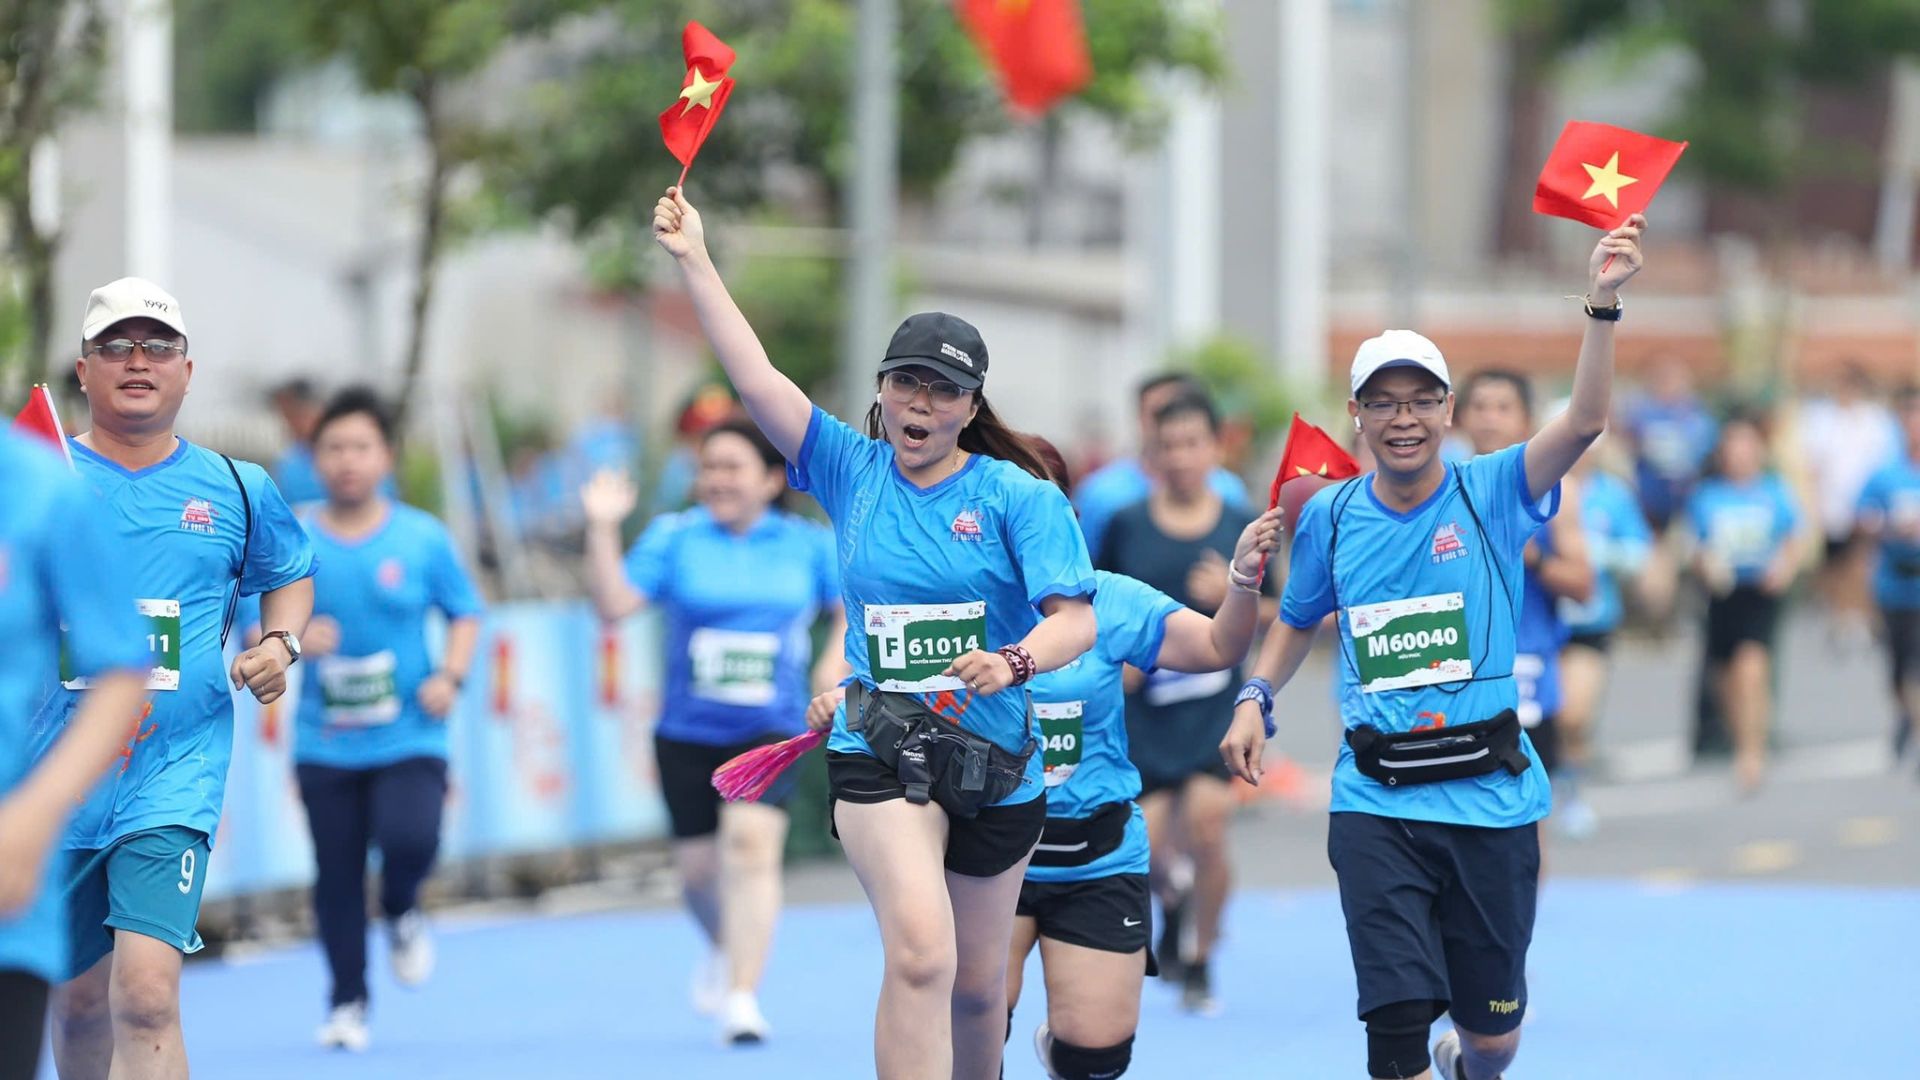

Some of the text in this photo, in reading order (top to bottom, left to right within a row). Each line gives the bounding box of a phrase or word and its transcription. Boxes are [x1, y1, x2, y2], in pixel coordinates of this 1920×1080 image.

[144, 299, 168, 312] 1992
[886, 634, 979, 657] F 61014
[1368, 627, 1458, 657] M60040
[177, 848, 195, 895] 9
